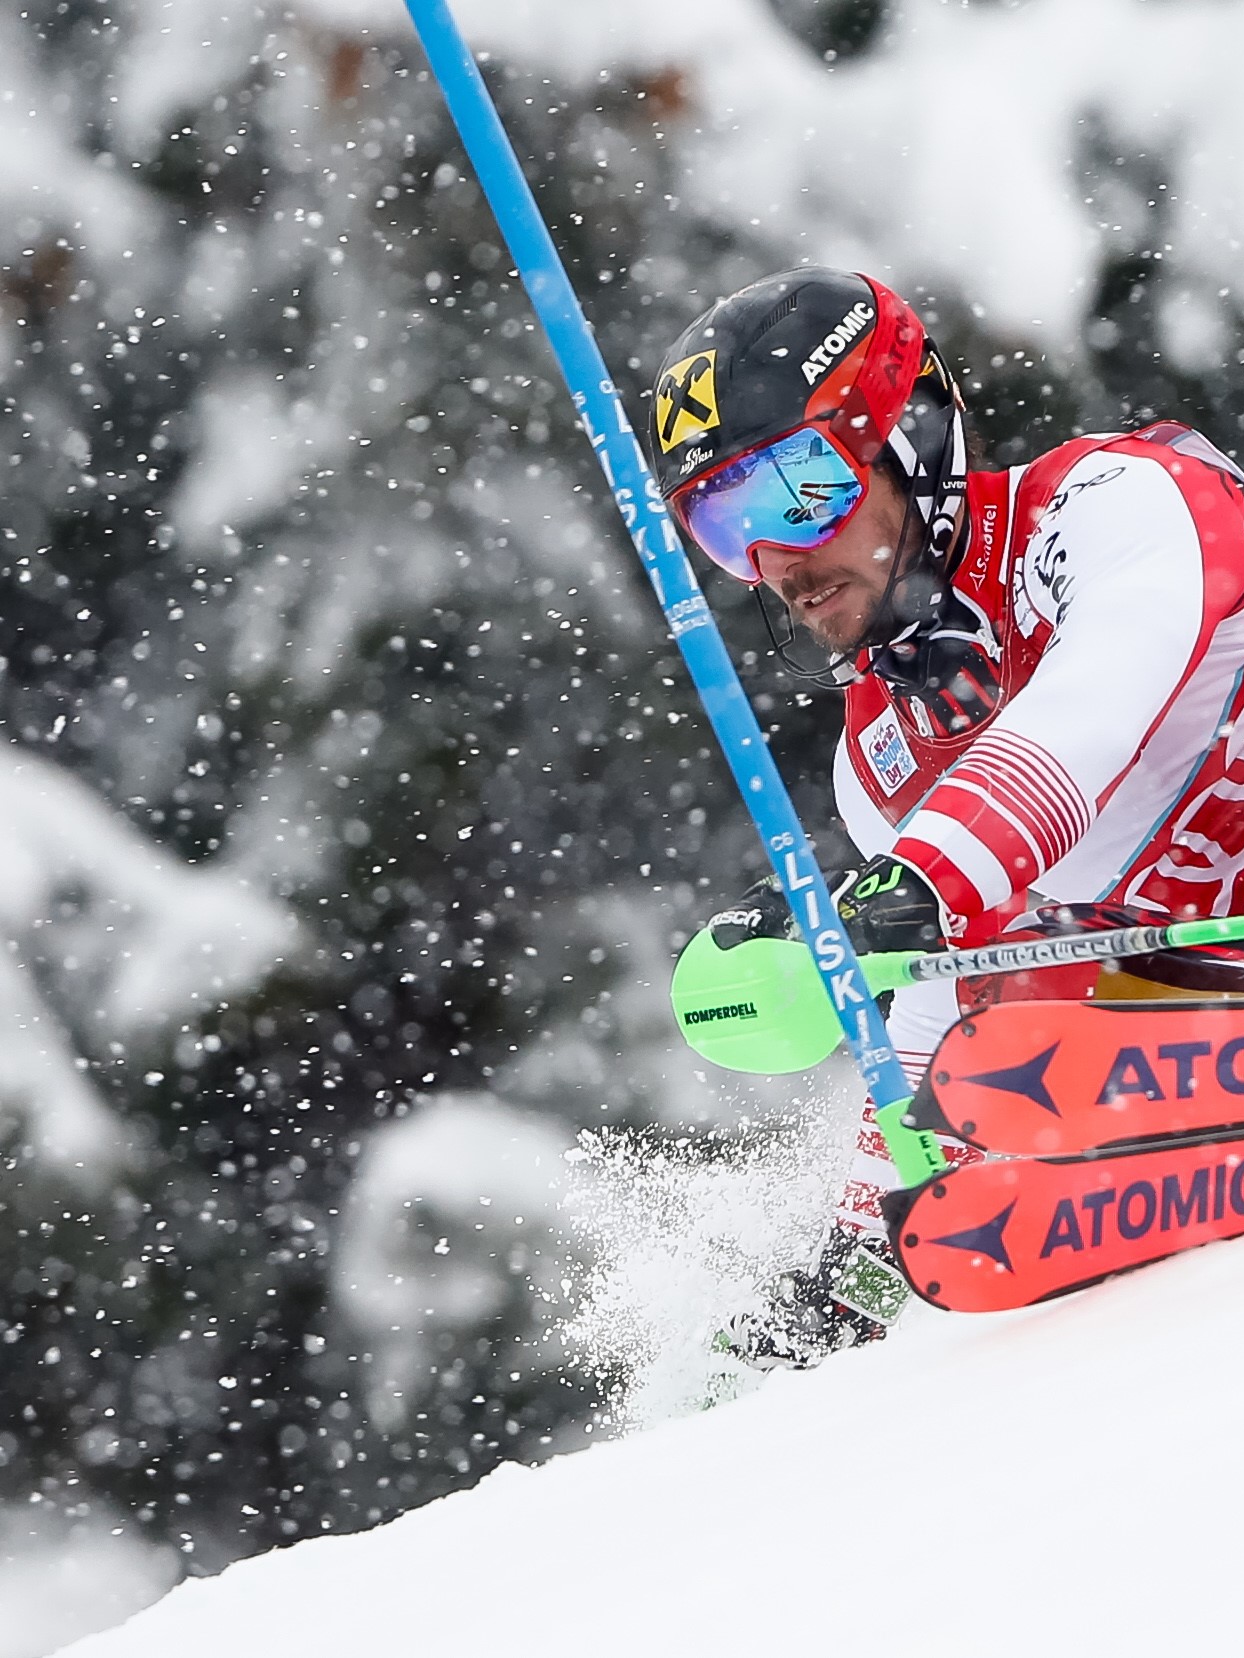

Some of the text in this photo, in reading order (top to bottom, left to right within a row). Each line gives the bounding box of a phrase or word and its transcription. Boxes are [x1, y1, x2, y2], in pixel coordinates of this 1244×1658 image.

[801, 302, 875, 386] ATOMIC
[866, 735, 903, 773] Snow
[784, 852, 870, 1048] LISKI
[683, 1002, 758, 1025] KOMPERDELL
